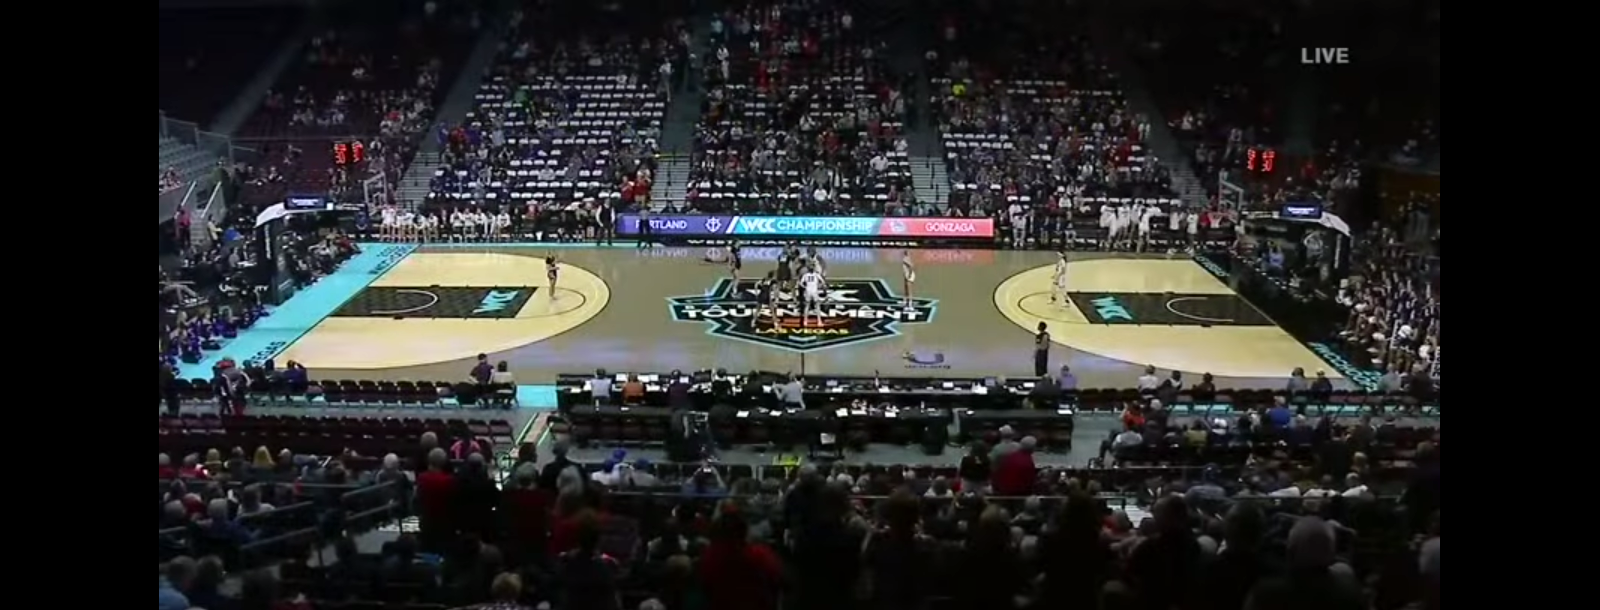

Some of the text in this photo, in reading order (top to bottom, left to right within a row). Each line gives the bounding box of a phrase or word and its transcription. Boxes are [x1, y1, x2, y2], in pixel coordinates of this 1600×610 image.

[635, 219, 688, 230] PRTLAND
[739, 218, 873, 232] WCC CHAMPIONSHIP
[925, 221, 975, 232] GONZAGA
